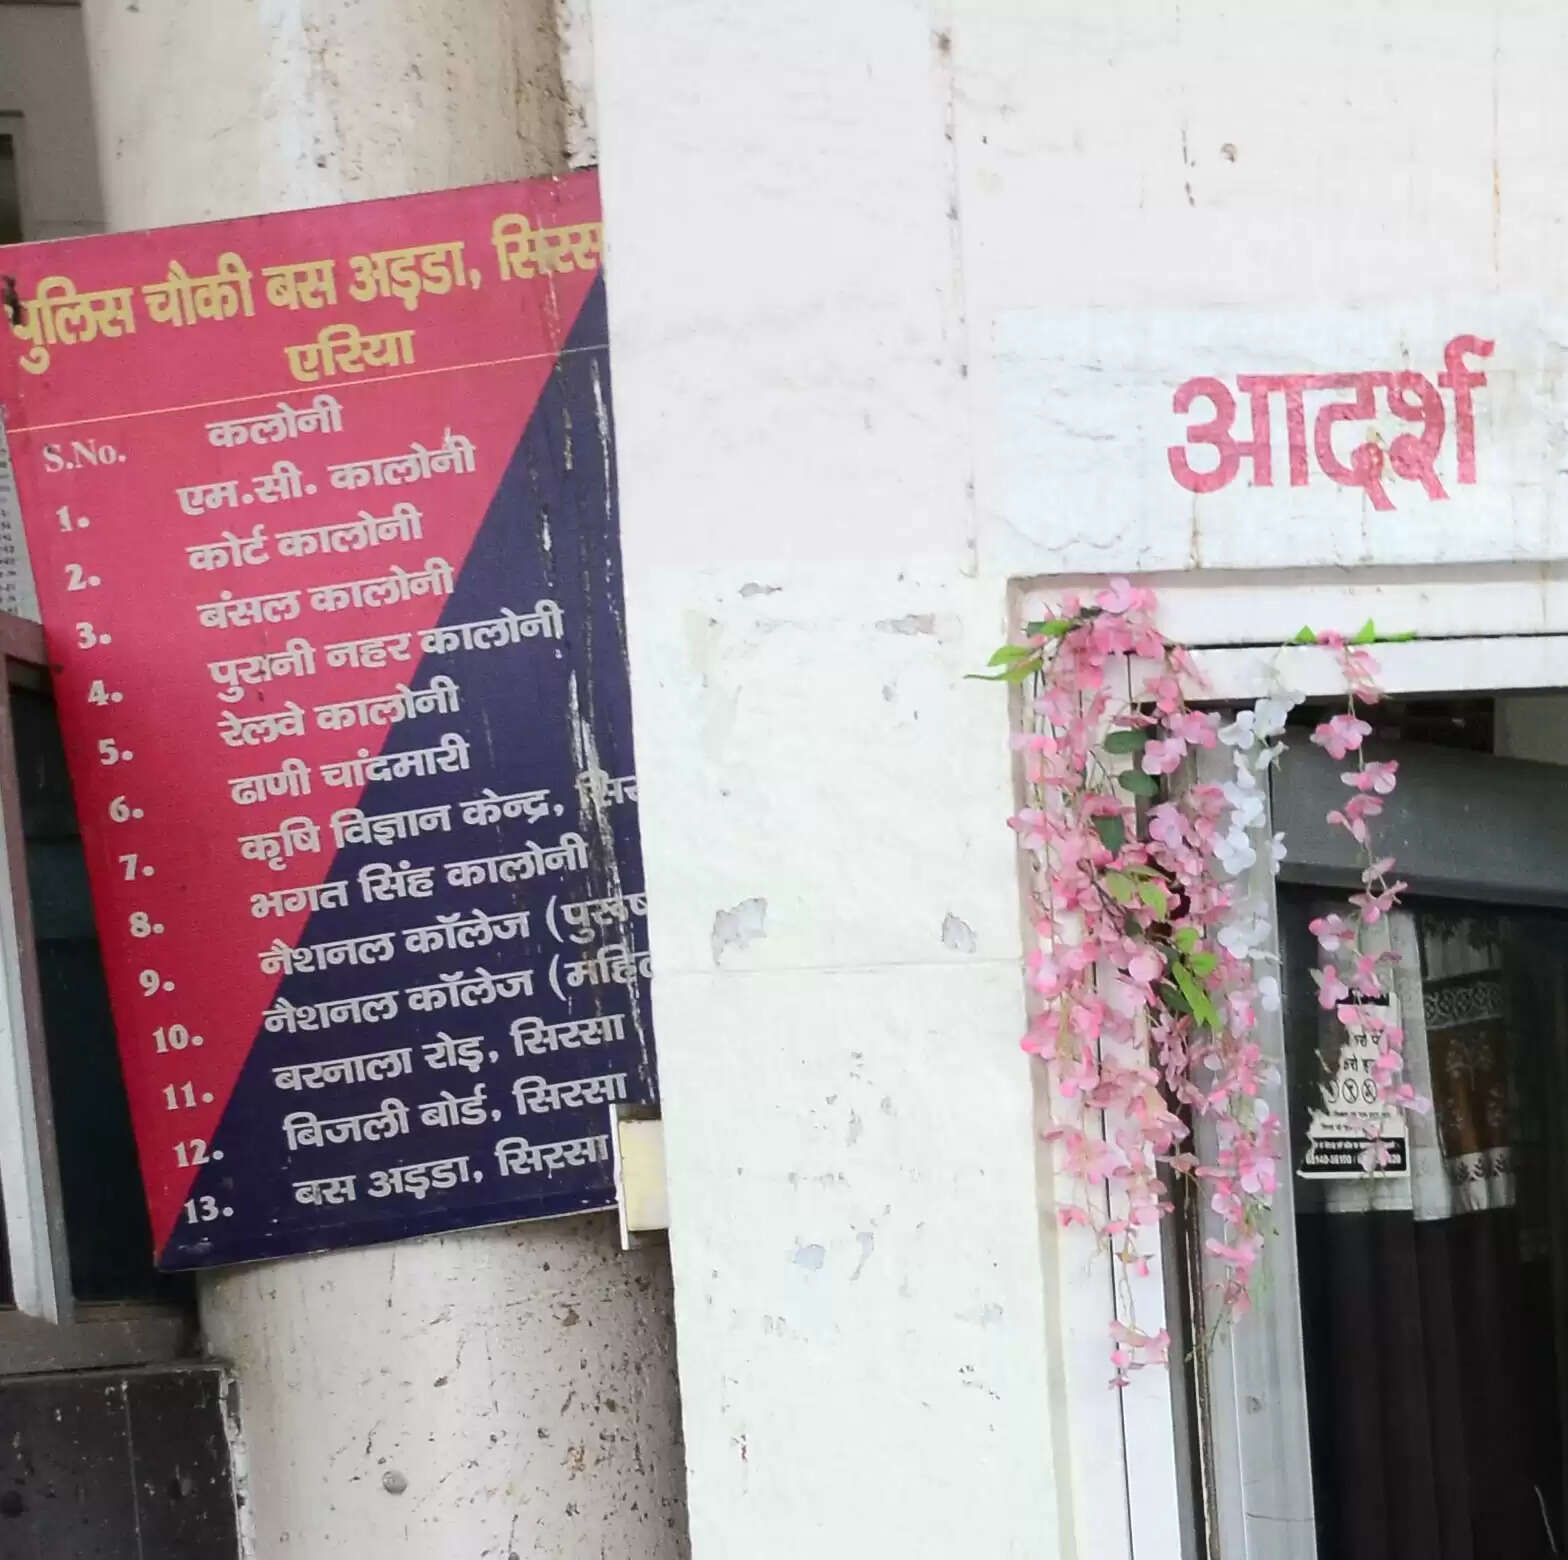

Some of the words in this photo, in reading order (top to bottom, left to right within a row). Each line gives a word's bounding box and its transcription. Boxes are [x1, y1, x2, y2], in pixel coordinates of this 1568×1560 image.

[5, 276, 136, 374] पुलिस
[142, 251, 256, 327] चौकी
[261, 259, 338, 309] बस
[284, 323, 416, 382] एरिया
[205, 394, 345, 447] कलोनी
[1167, 334, 1495, 511] आदर्श
[43, 438, 127, 472] S.No.
[175, 460, 318, 516] एम.सी.
[327, 433, 477, 490] कालोनी
[56, 505, 90, 532] 1.
[185, 524, 270, 571] कोर्ट
[275, 502, 424, 557] कालोनी
[65, 563, 101, 591] 2.
[197, 590, 302, 629] बंसल
[308, 557, 455, 612] कालोनी
[76, 622, 112, 649] 3.
[208, 638, 317, 703] पुरानी
[324, 632, 413, 668] नहर
[418, 599, 565, 656] कालोनी
[88, 680, 124, 706] 4.
[217, 701, 305, 748] रेलवे
[314, 675, 460, 731] कालोनी
[98, 738, 134, 765] 5.
[228, 758, 312, 805] ढाणी
[320, 733, 470, 788] चांदमारी
[109, 796, 145, 823] 6.
[238, 817, 320, 872] कृषि
[331, 803, 452, 848] विज्ञान
[459, 788, 565, 826] केन्द्र,
[118, 854, 155, 881] 7.
[250, 880, 349, 919] भगत
[358, 862, 435, 903] सिंह
[443, 832, 589, 889] कालोनी
[129, 912, 165, 938] 8.
[258, 938, 396, 977] नैशनल
[402, 908, 531, 955] कॉलेज
[139, 970, 175, 997] 9.
[262, 993, 398, 1034] नैशनल
[405, 967, 534, 1013] कॉलेज
[152, 1024, 203, 1053] 10.
[272, 1048, 412, 1091] बरनाला
[421, 1032, 499, 1073] रोड़,
[509, 1016, 626, 1056] सिरसा
[163, 1081, 213, 1109] 11.
[282, 1098, 410, 1150] बिजली
[418, 1084, 502, 1128] बोर्ड,
[512, 1075, 628, 1115] सिरसा
[173, 1138, 224, 1168] 12.
[293, 1175, 356, 1205] बस
[494, 1137, 610, 1176] सिरसा
[184, 1195, 233, 1223] 13.
